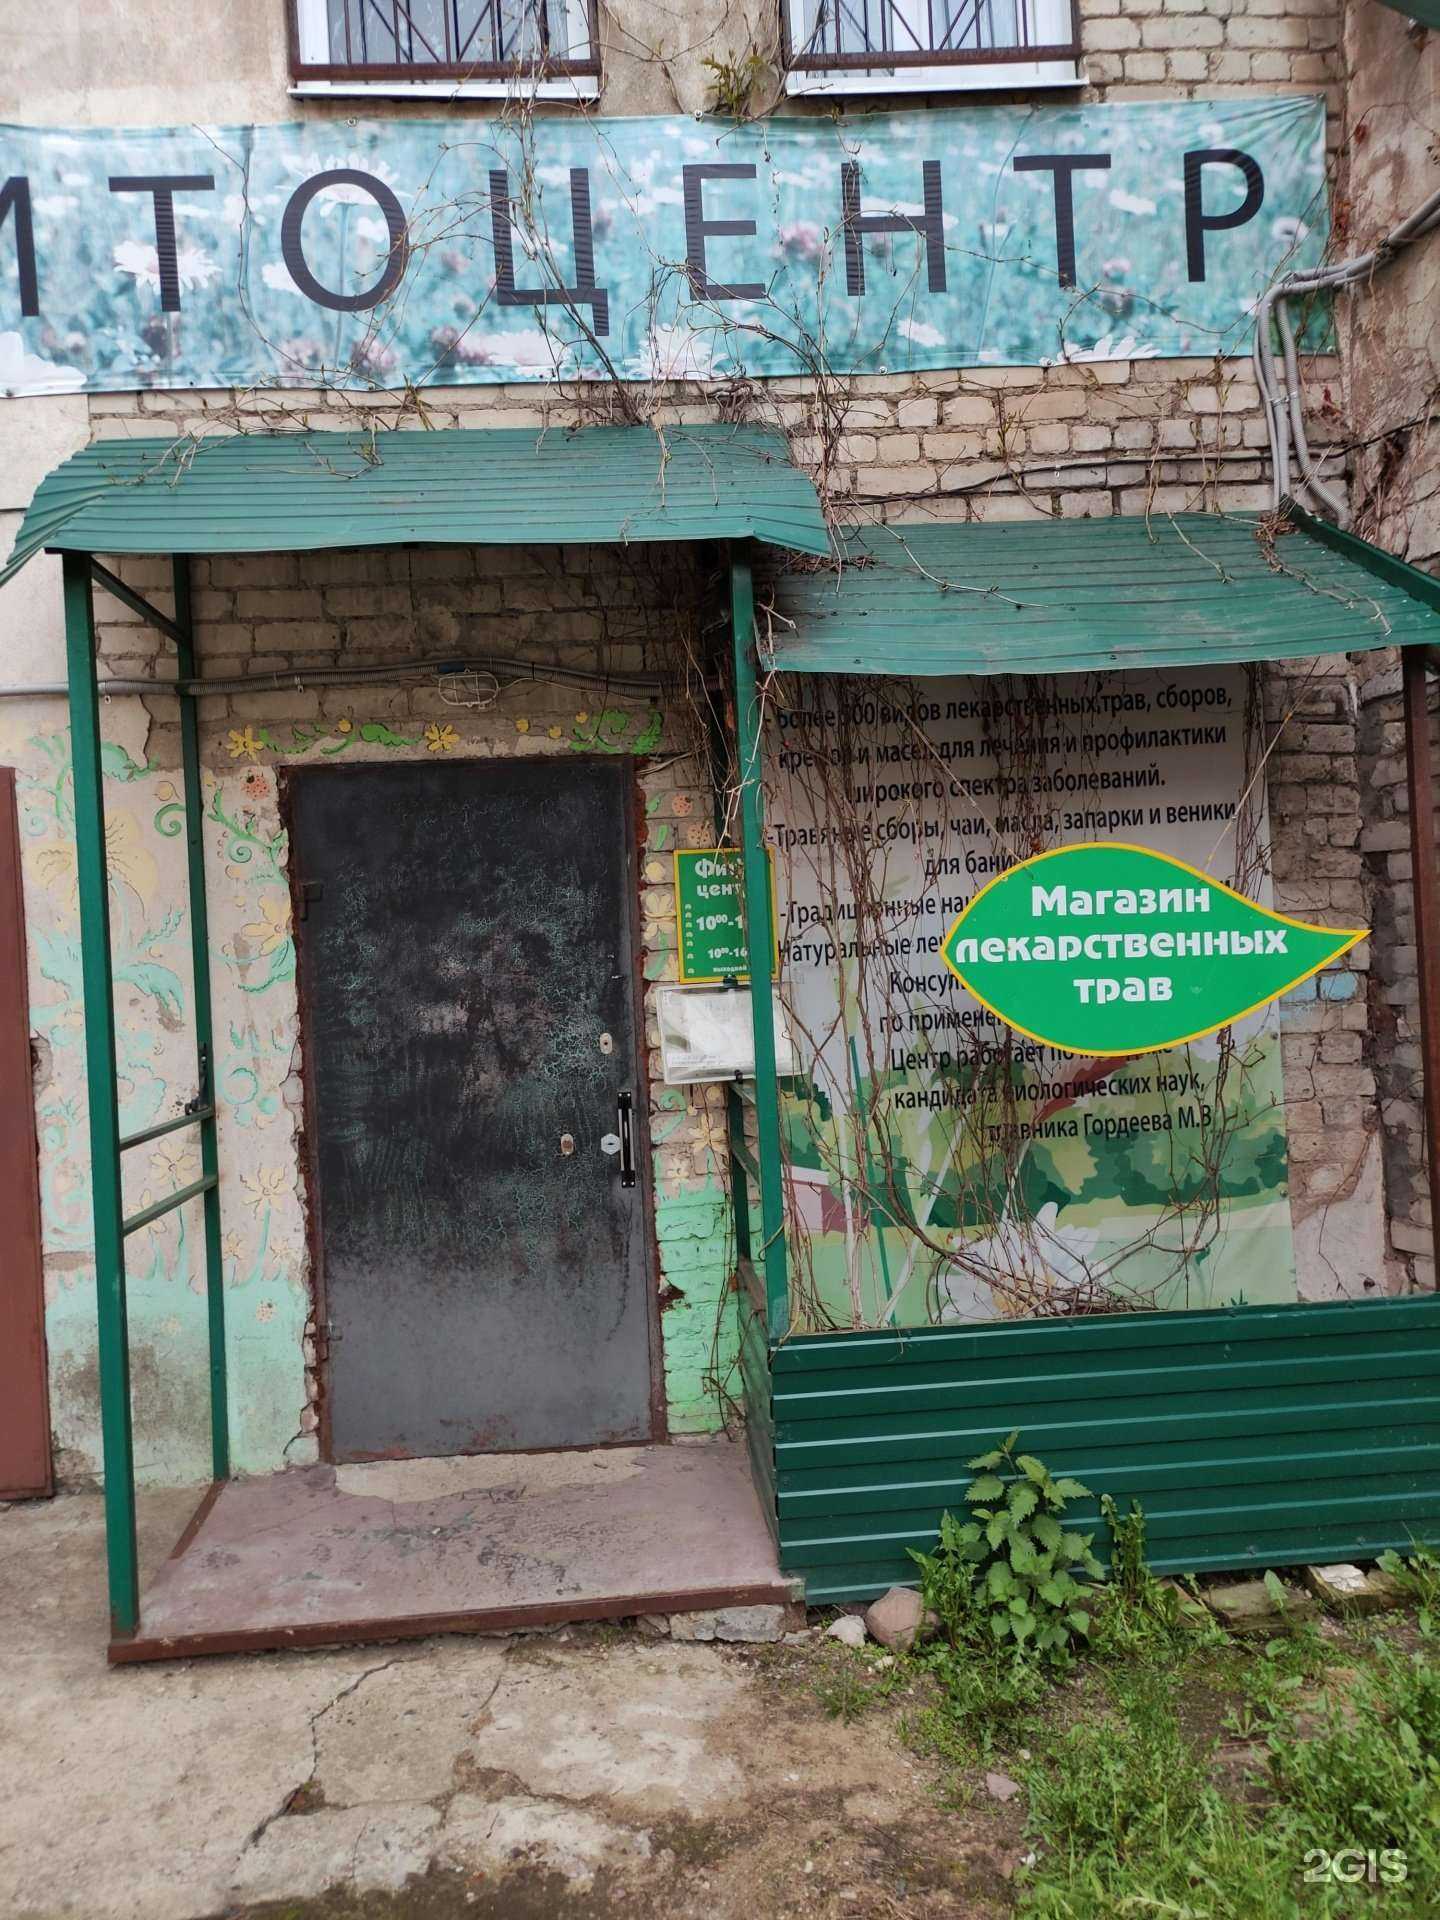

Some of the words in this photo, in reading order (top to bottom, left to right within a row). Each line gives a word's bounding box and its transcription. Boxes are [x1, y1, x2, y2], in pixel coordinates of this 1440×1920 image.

[841, 702, 876, 727] 00
[1156, 683, 1232, 711] сборов,
[939, 739, 974, 763] для
[1082, 726, 1226, 757] профилактики
[1033, 763, 1166, 795] заболеваний.
[951, 815, 991, 838] чаи,
[1063, 804, 1144, 834] запарки
[1149, 806, 1161, 825] и
[1166, 801, 1236, 825] веники
[925, 857, 960, 879] для
[1030, 884, 1211, 917] Магазин
[955, 929, 1289, 964] лекарственных
[889, 971, 966, 997] Консул
[1072, 975, 1174, 1005] трав
[890, 1048, 951, 1075] Центр
[1003, 1075, 1152, 1102] иологических
[1156, 1073, 1205, 1096] наук,
[1083, 1112, 1173, 1140] Гордеева
